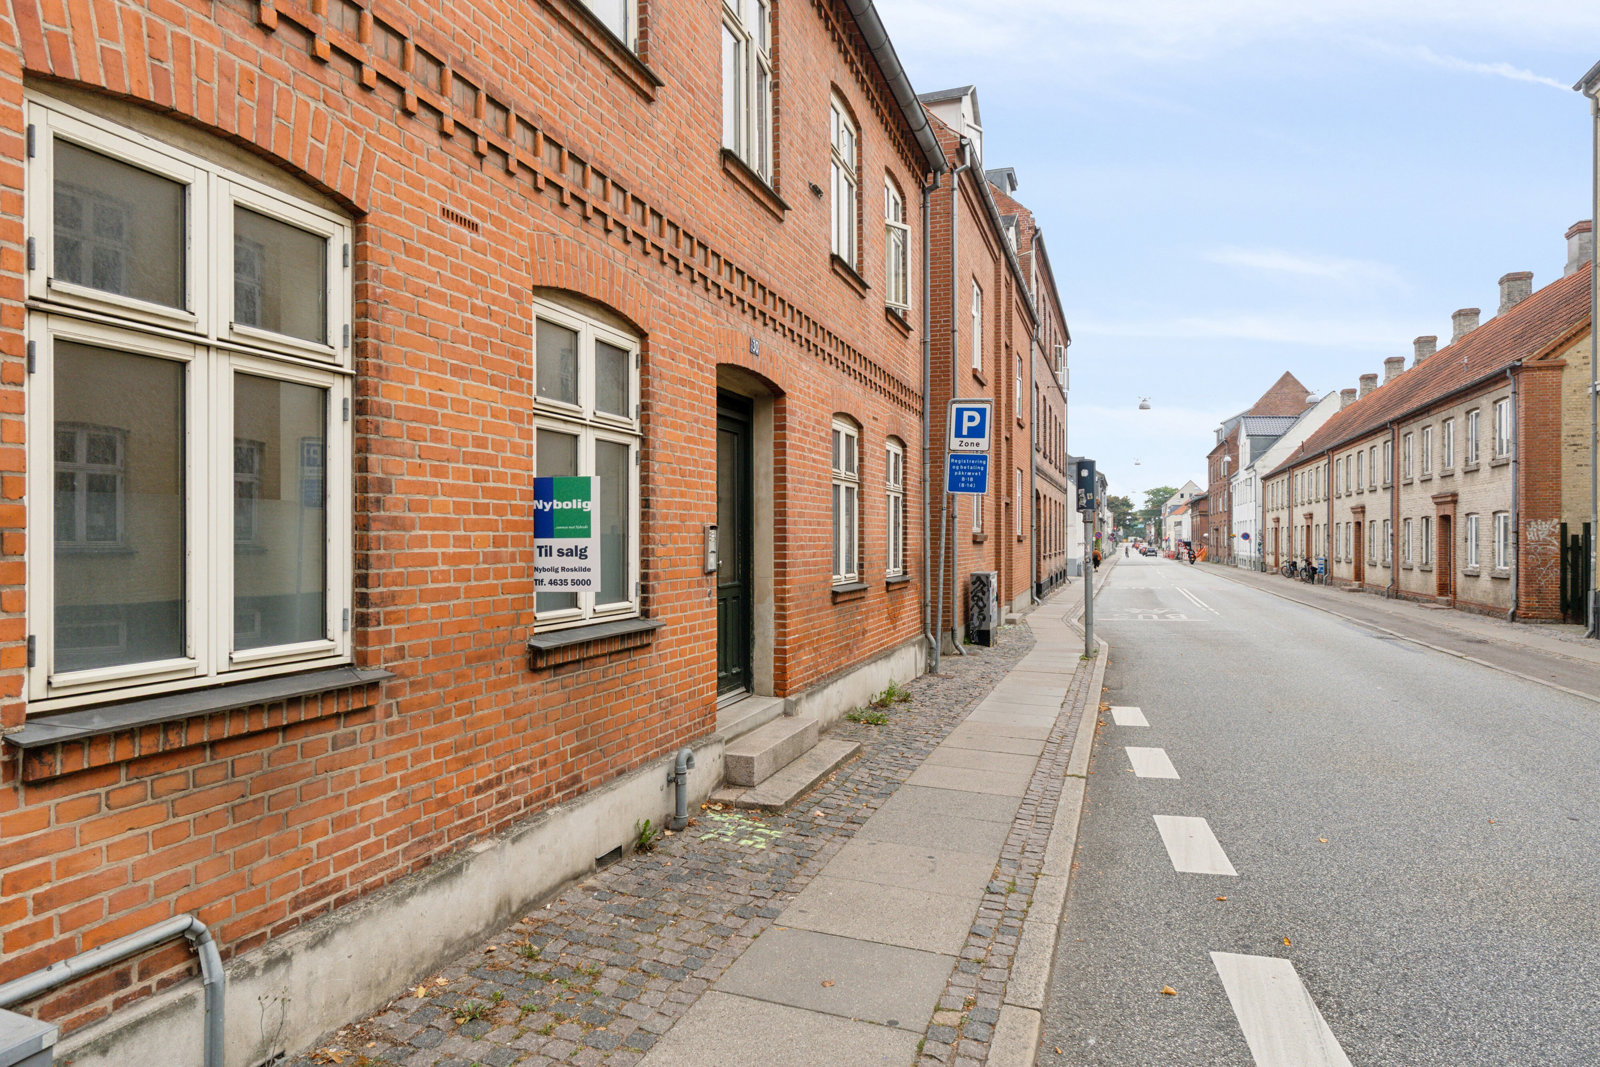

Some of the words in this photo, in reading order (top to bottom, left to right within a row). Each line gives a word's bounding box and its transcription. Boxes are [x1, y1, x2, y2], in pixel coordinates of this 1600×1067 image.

[962, 411, 981, 435] P
[534, 499, 592, 512] Nybolig
[537, 545, 553, 557] Til
[556, 545, 588, 560] salg
[534, 578, 546, 586] Tlf.
[547, 578, 569, 587] 4635
[570, 578, 592, 587] 5000
